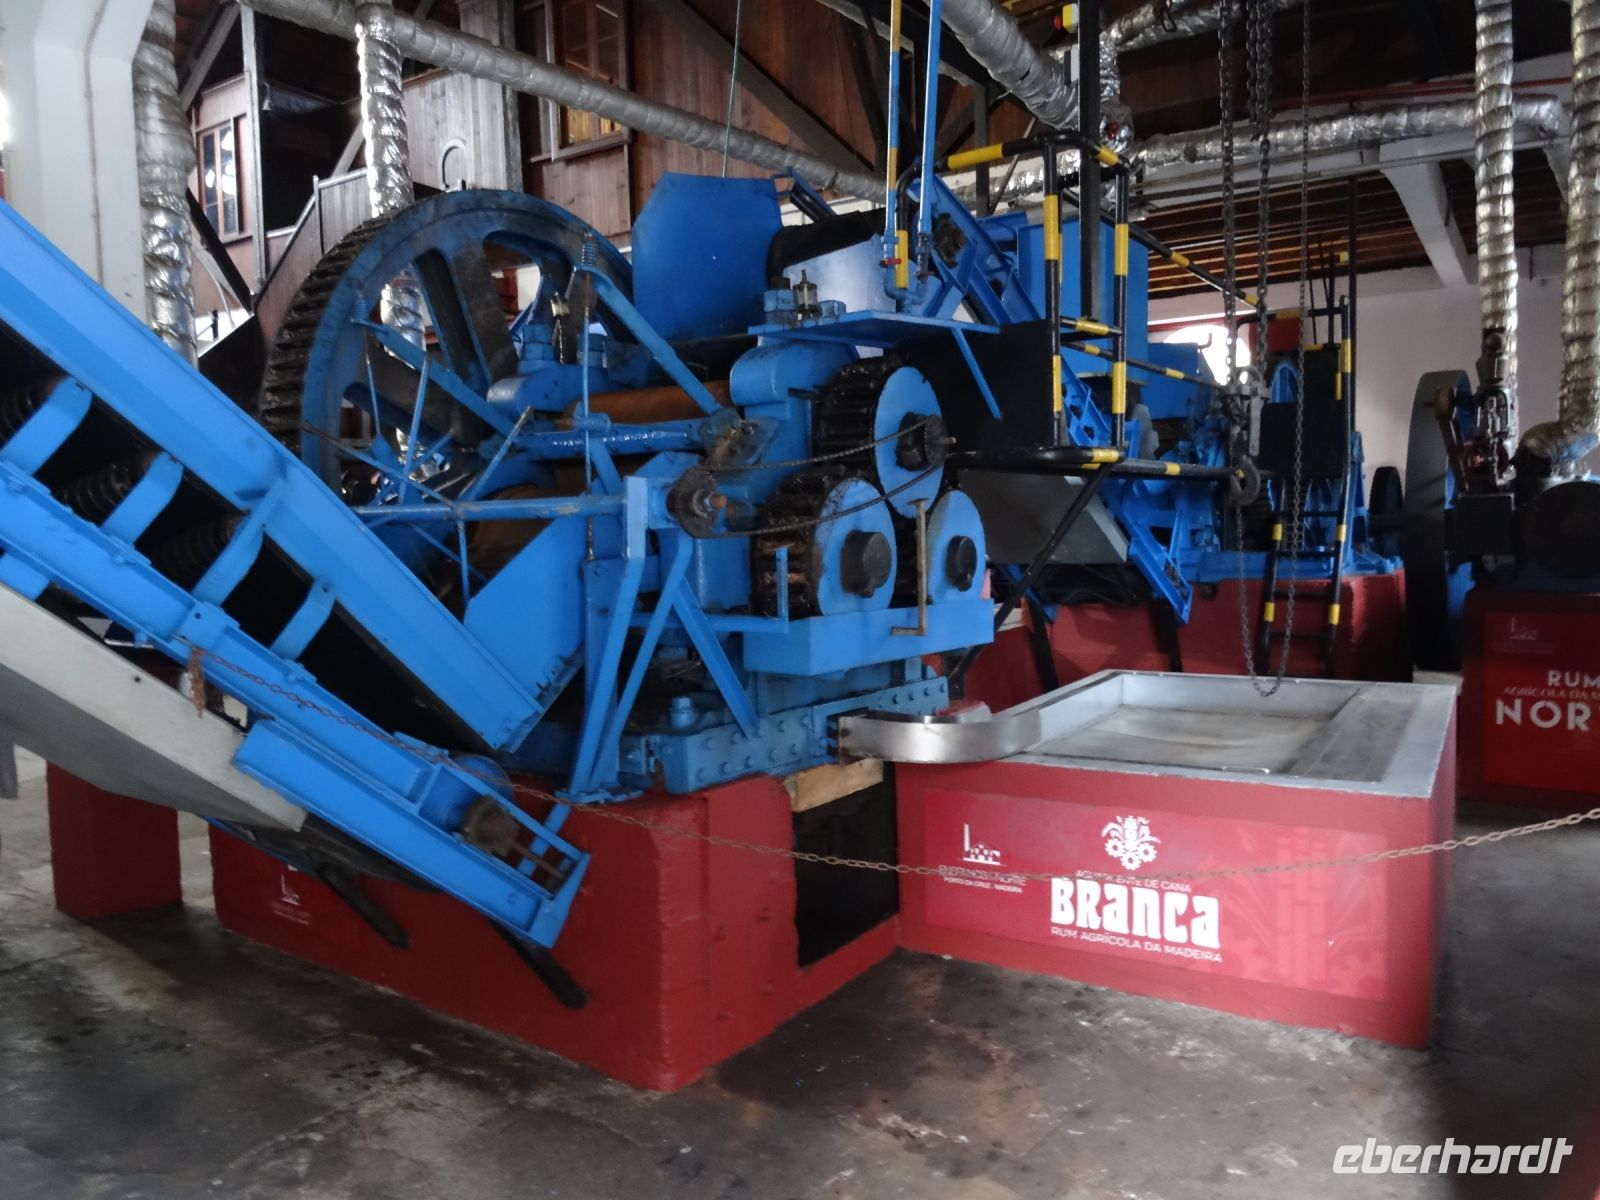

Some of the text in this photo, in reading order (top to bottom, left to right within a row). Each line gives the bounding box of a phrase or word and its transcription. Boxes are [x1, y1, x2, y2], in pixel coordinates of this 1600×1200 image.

[1548, 670, 1600, 688] RUM
[1496, 698, 1600, 732] NOR
[1144, 879, 1159, 888] DE
[1051, 926, 1223, 964] RUM AGRÍCOLA DA MADEIRA
